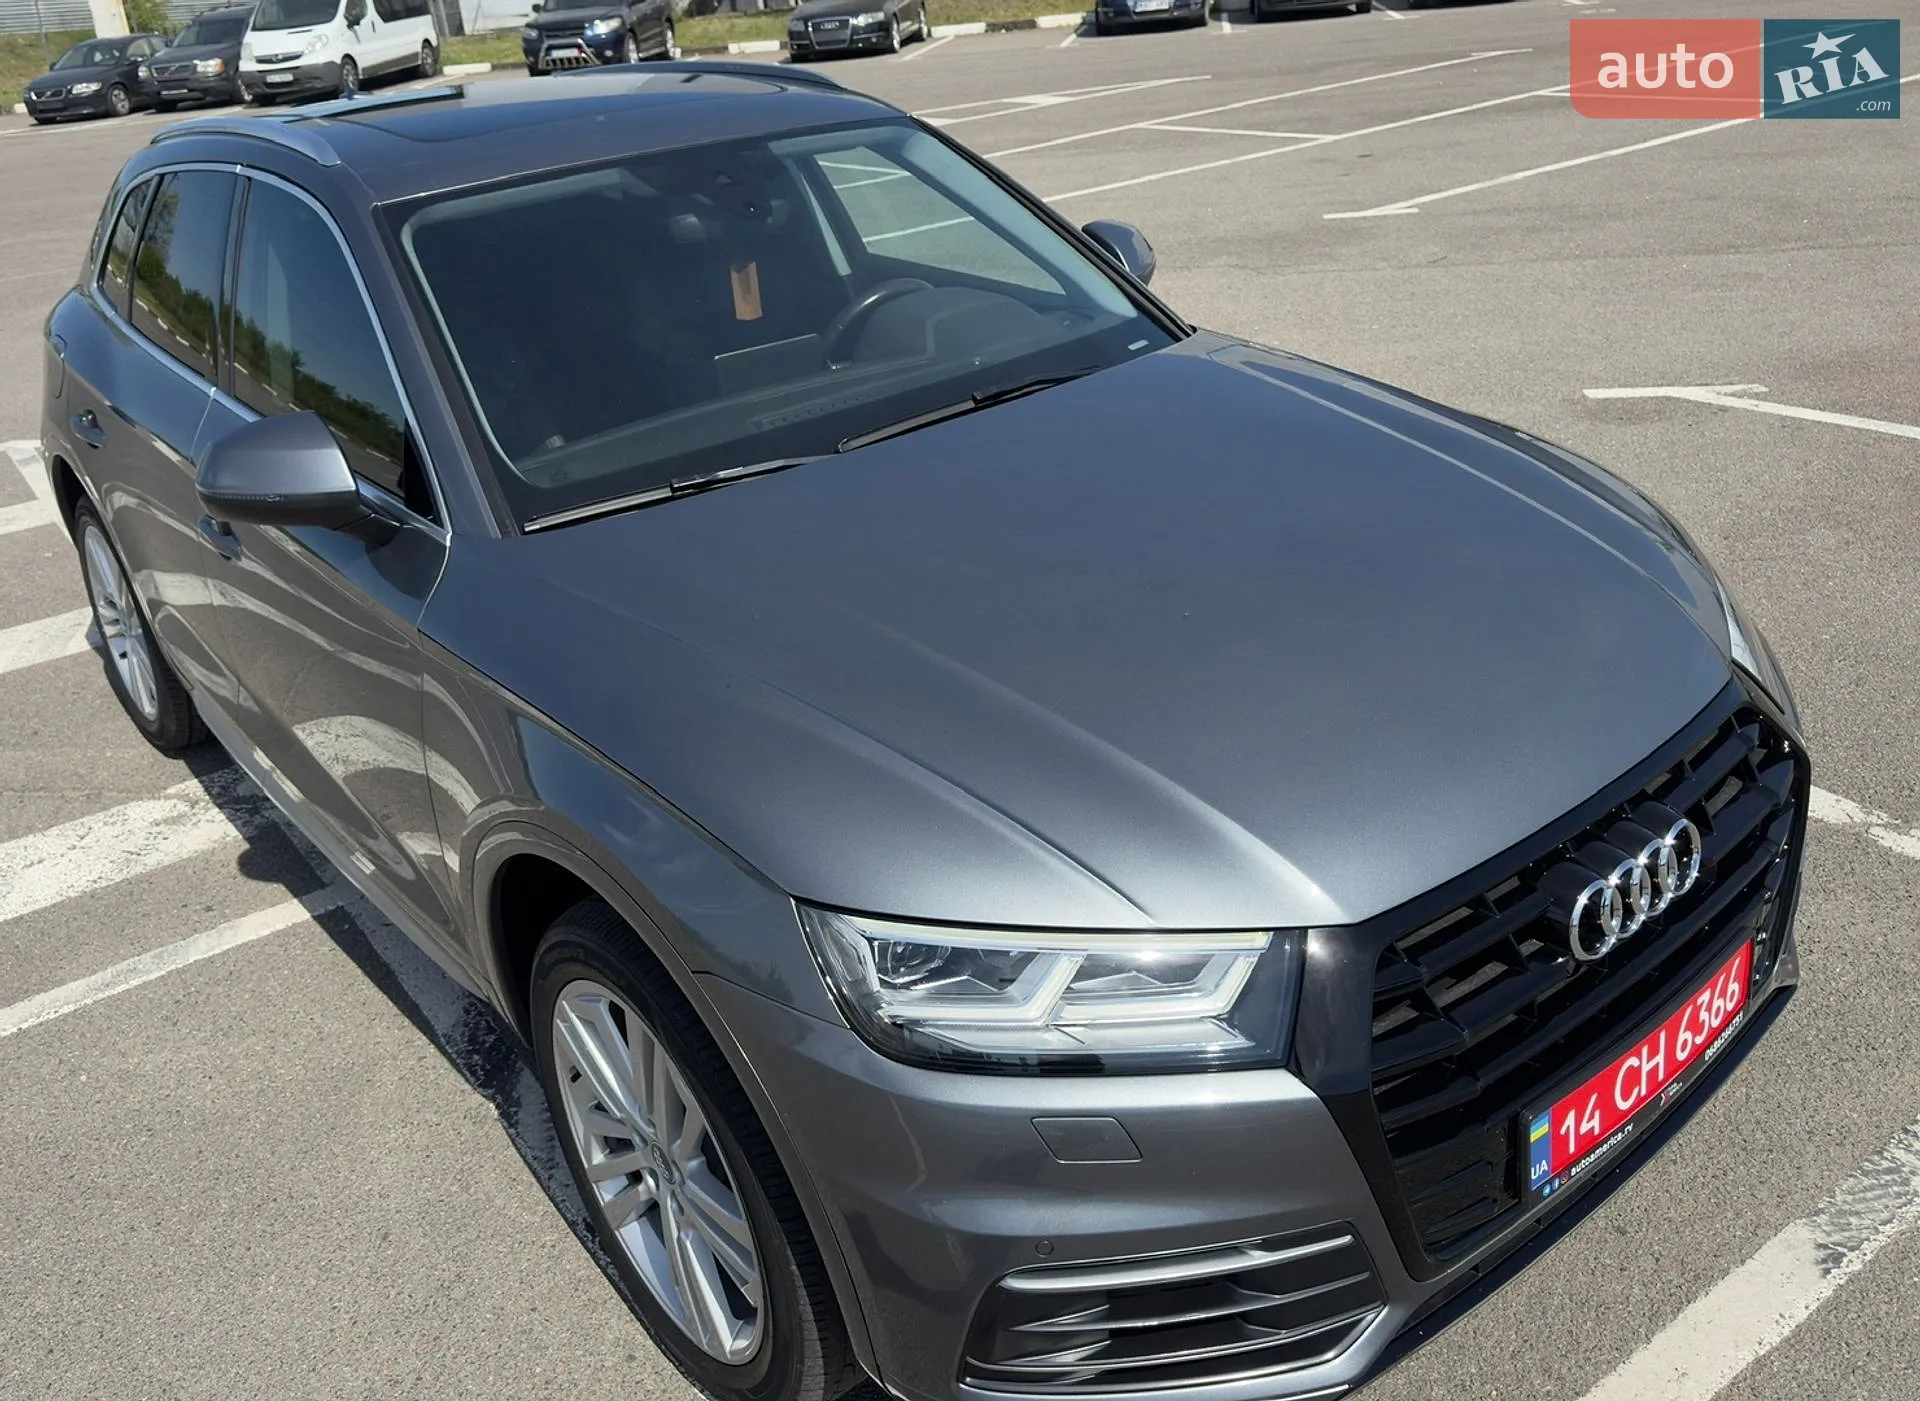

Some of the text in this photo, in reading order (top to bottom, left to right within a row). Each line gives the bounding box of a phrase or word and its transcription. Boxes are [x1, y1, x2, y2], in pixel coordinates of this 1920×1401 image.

[1560, 956, 1741, 1154] 14 CH 6366
[1531, 1160, 1549, 1180] UA
